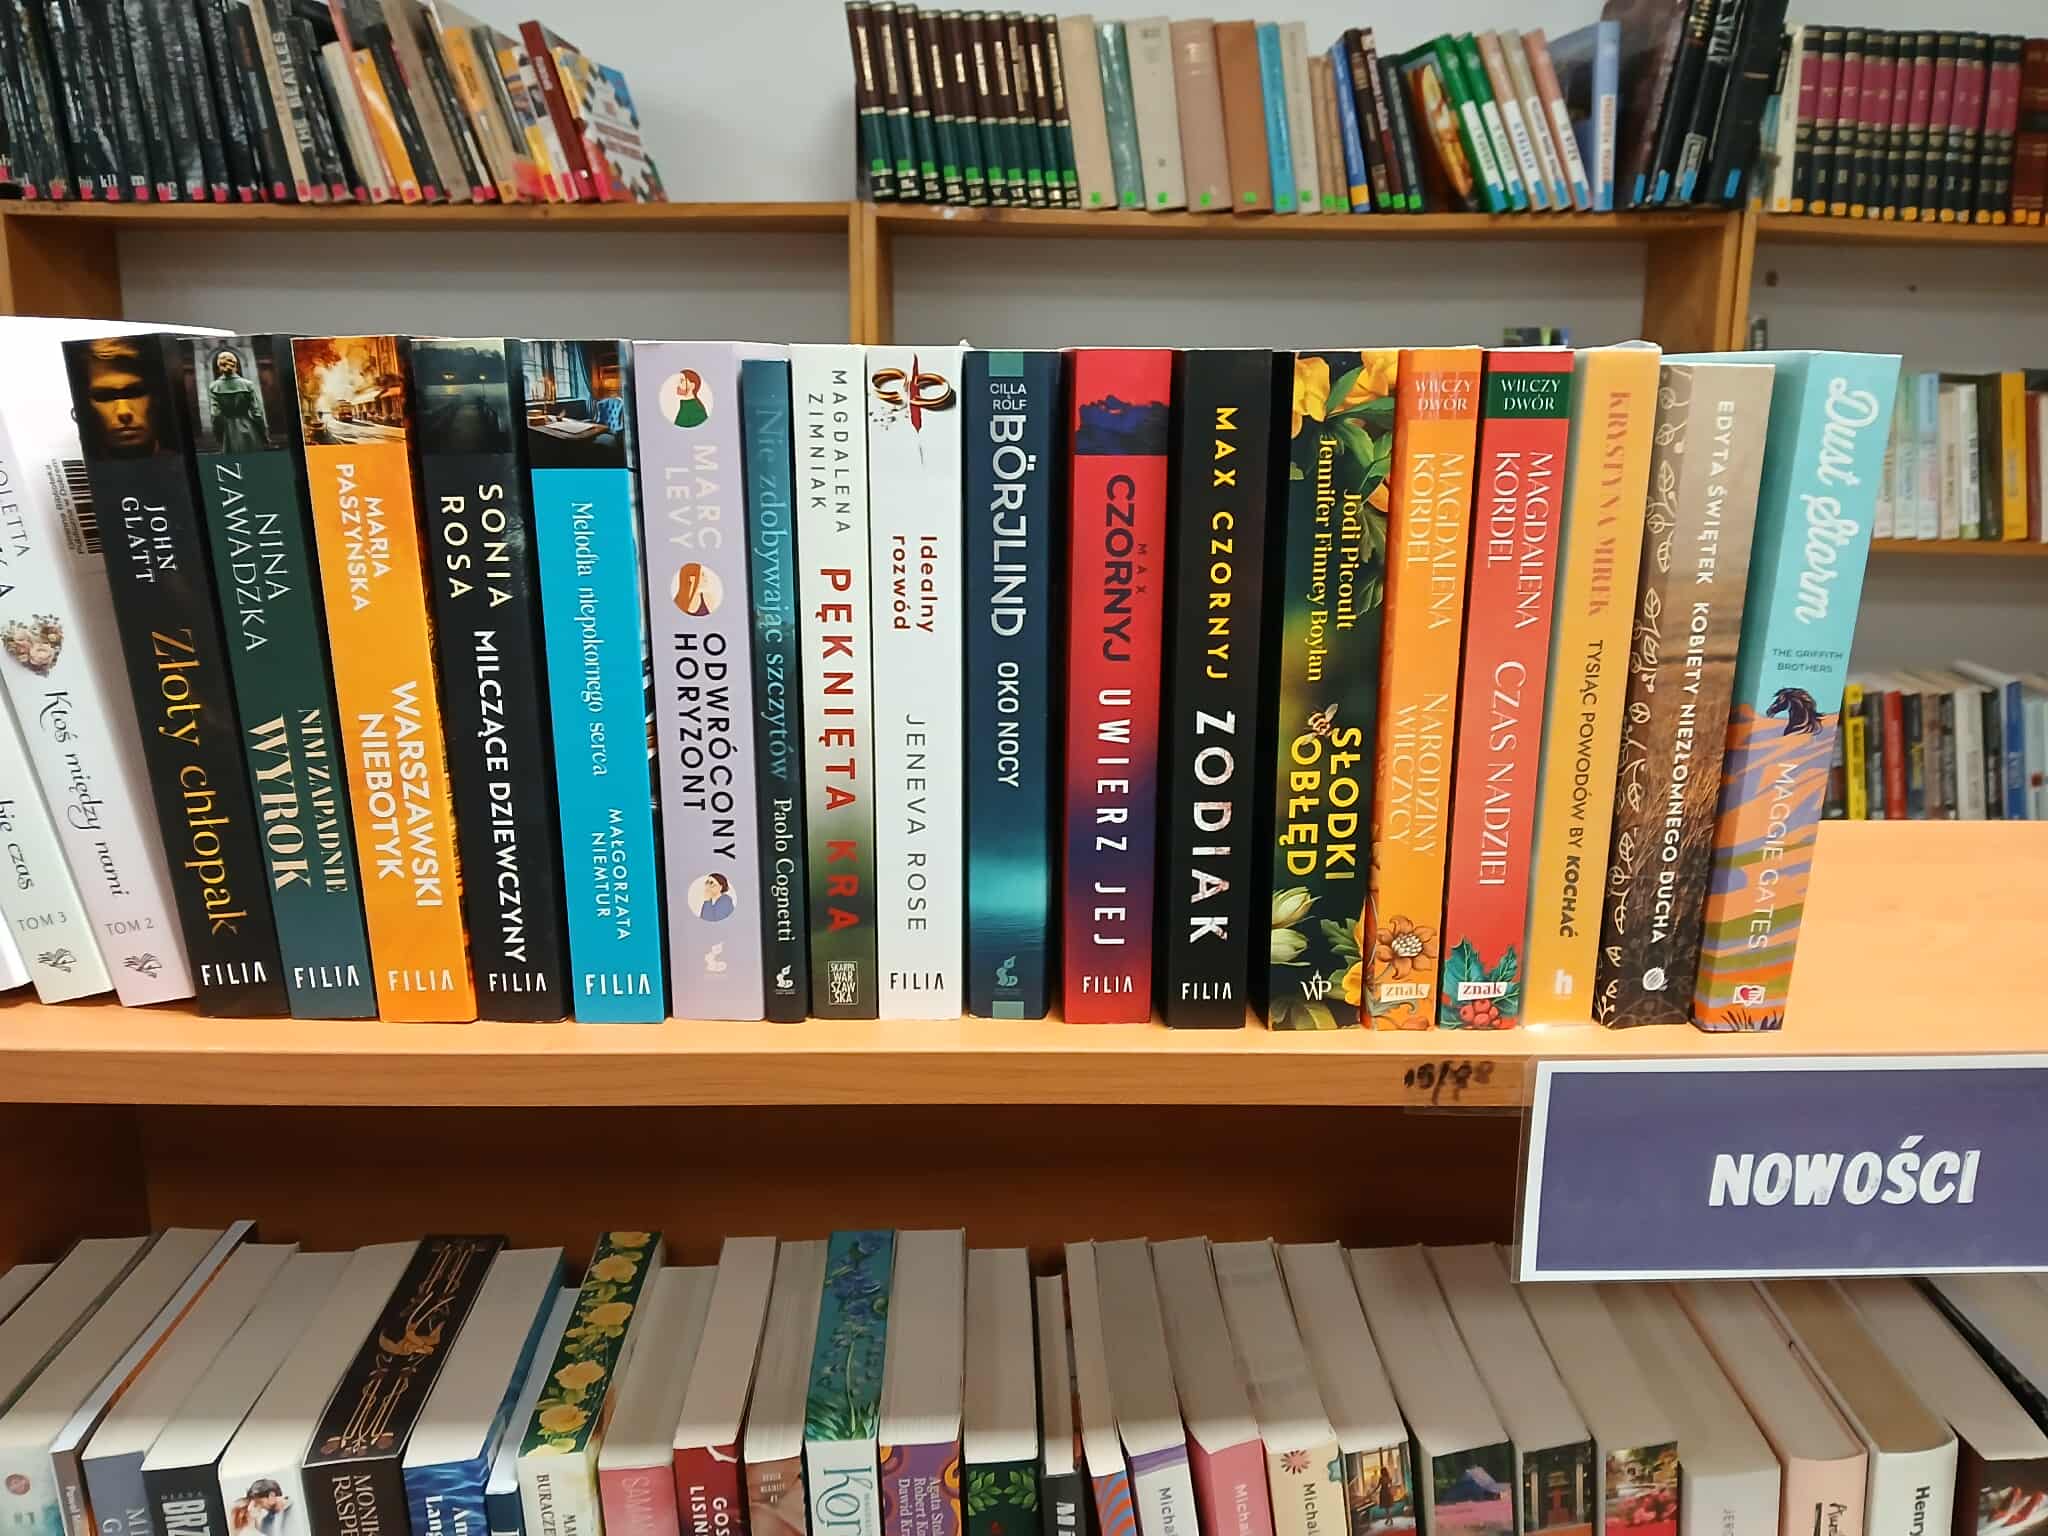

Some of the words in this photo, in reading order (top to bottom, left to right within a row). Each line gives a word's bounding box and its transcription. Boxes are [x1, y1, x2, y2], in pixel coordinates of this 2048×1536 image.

[989, 383, 1027, 395] CILLA
[993, 398, 1027, 410] ROLF
[1416, 379, 1472, 393] WILCZY
[1418, 394, 1468, 411] DWÓR
[1500, 378, 1560, 394] WILCZY
[1503, 393, 1555, 411] DWÓR
[755, 408, 784, 456] Nie
[808, 393, 827, 508] ZIMNIAK
[831, 370, 852, 533] MAGDALENA
[1213, 407, 1239, 487] MAX
[1597, 391, 1632, 528] KRYSTYNA
[1707, 401, 1735, 476] EDYTA
[1816, 376, 1880, 488] Dust
[664, 466, 693, 550] LEVY
[692, 444, 722, 551] MARC
[1315, 433, 1338, 527] Jennifer
[1341, 489, 1362, 544] Jodi
[1407, 453, 1436, 568] KORDEL
[1487, 452, 1521, 568] KORDEL
[121, 497, 156, 583] GLATT
[144, 503, 178, 571] JOHN
[215, 462, 268, 651] ZAWADZKA
[255, 512, 292, 599] NINA
[335, 463, 371, 611] PASZYŃSKA
[364, 496, 392, 578] MARIA
[440, 495, 473, 599] ROSA
[478, 484, 513, 608] SONIA
[571, 502, 600, 577] Melodia
[754, 474, 789, 644] zdobywając
[989, 414, 1038, 637] BÖRJLIND
[1103, 474, 1135, 663] CZORNYJ
[1427, 453, 1465, 629] MAGDALENA
[1514, 451, 1553, 629] MAGDALENA
[1695, 484, 1728, 584] ŚWIĘTEK
[1794, 493, 1860, 624] Storm
[891, 535, 912, 630] rozwód
[915, 535, 938, 633] Idealny
[1136, 543, 1148, 595] MAX
[1206, 511, 1234, 680] CZORNYJ
[1307, 533, 1332, 605] Finney
[1336, 546, 1360, 631] Picoult
[1588, 537, 1617, 617] MIREK
[573, 586, 605, 713] niepokornego
[815, 567, 857, 811] PĘKNIĘTA
[997, 662, 1019, 714] OKO
[1305, 611, 1328, 682] Boylan
[1579, 640, 1603, 706] TYSIĄC
[1683, 602, 1710, 697] KOBIETY
[1773, 648, 1793, 658] THE
[1795, 649, 1844, 660] GRIFFITH
[1776, 663, 1833, 673] BROTHERS
[297, 708, 328, 758] NIM
[473, 630, 509, 772] MILCZĄCE
[674, 633, 705, 810] HORYZONT
[761, 653, 795, 780] szczytów
[1487, 661, 1527, 753] CZAS
[151, 628, 201, 747] Złoty
[179, 765, 248, 937] chłopak
[590, 722, 608, 777] serca
[703, 633, 737, 859] ODWRÓCONY
[905, 713, 927, 835] JENEVA
[997, 722, 1019, 788] NOCY
[1096, 688, 1132, 852] UWIERZ
[1388, 704, 1418, 843] WILCZYCY
[1412, 692, 1449, 856] NARODZINY
[1572, 712, 1596, 821] POWODÓW
[1661, 703, 1696, 864] NIEZŁOMNEGO
[39, 689, 77, 744] Ktoś
[64, 752, 105, 831] między
[95, 841, 130, 897] nami
[247, 713, 312, 891] WYROK
[306, 765, 348, 894] ZAPADNIE
[358, 713, 405, 880] NIEBOTYK
[391, 681, 443, 907] WARSZAWSKI
[772, 798, 794, 852] Paolo
[1190, 710, 1236, 944] ZODIAK
[1279, 738, 1322, 876] OBŁĘD
[1325, 727, 1362, 880] SŁODKI
[1479, 763, 1513, 886] NADZIEI
[1760, 762, 1798, 861] MAGGIE
[8, 844, 34, 889] czas
[489, 782, 527, 963] DZIEWCZYNY
[591, 832, 611, 918] NIEMTUR
[608, 808, 632, 941] MAŁGORZATA
[1569, 826, 1586, 849] BY
[17, 913, 54, 931] TOM
[57, 911, 68, 924] 3
[105, 920, 142, 936] TOM
[144, 917, 155, 930] 2
[771, 857, 796, 943] Cognetti
[826, 840, 860, 934] KRA
[907, 852, 927, 931] ROSE
[1094, 881, 1126, 946] JEJ
[1559, 854, 1581, 939] KOCHAĆ
[1650, 871, 1675, 944] DUCHA
[1747, 869, 1779, 950] GATES
[201, 961, 268, 986] FILIA
[294, 965, 361, 989] FILIA
[388, 969, 455, 992] FILIA
[489, 973, 547, 993] FILIA
[585, 973, 651, 995] FILIA
[890, 972, 944, 992] FILIA
[1083, 976, 1133, 994] FILIA
[1181, 982, 1232, 1000] FILIA
[1386, 984, 1425, 998] znak
[1463, 982, 1504, 996] znak
[1709, 1134, 1982, 1207] NOWOŚCI
[898, 1478, 912, 1516] Dawid
[914, 1477, 927, 1518] Robert
